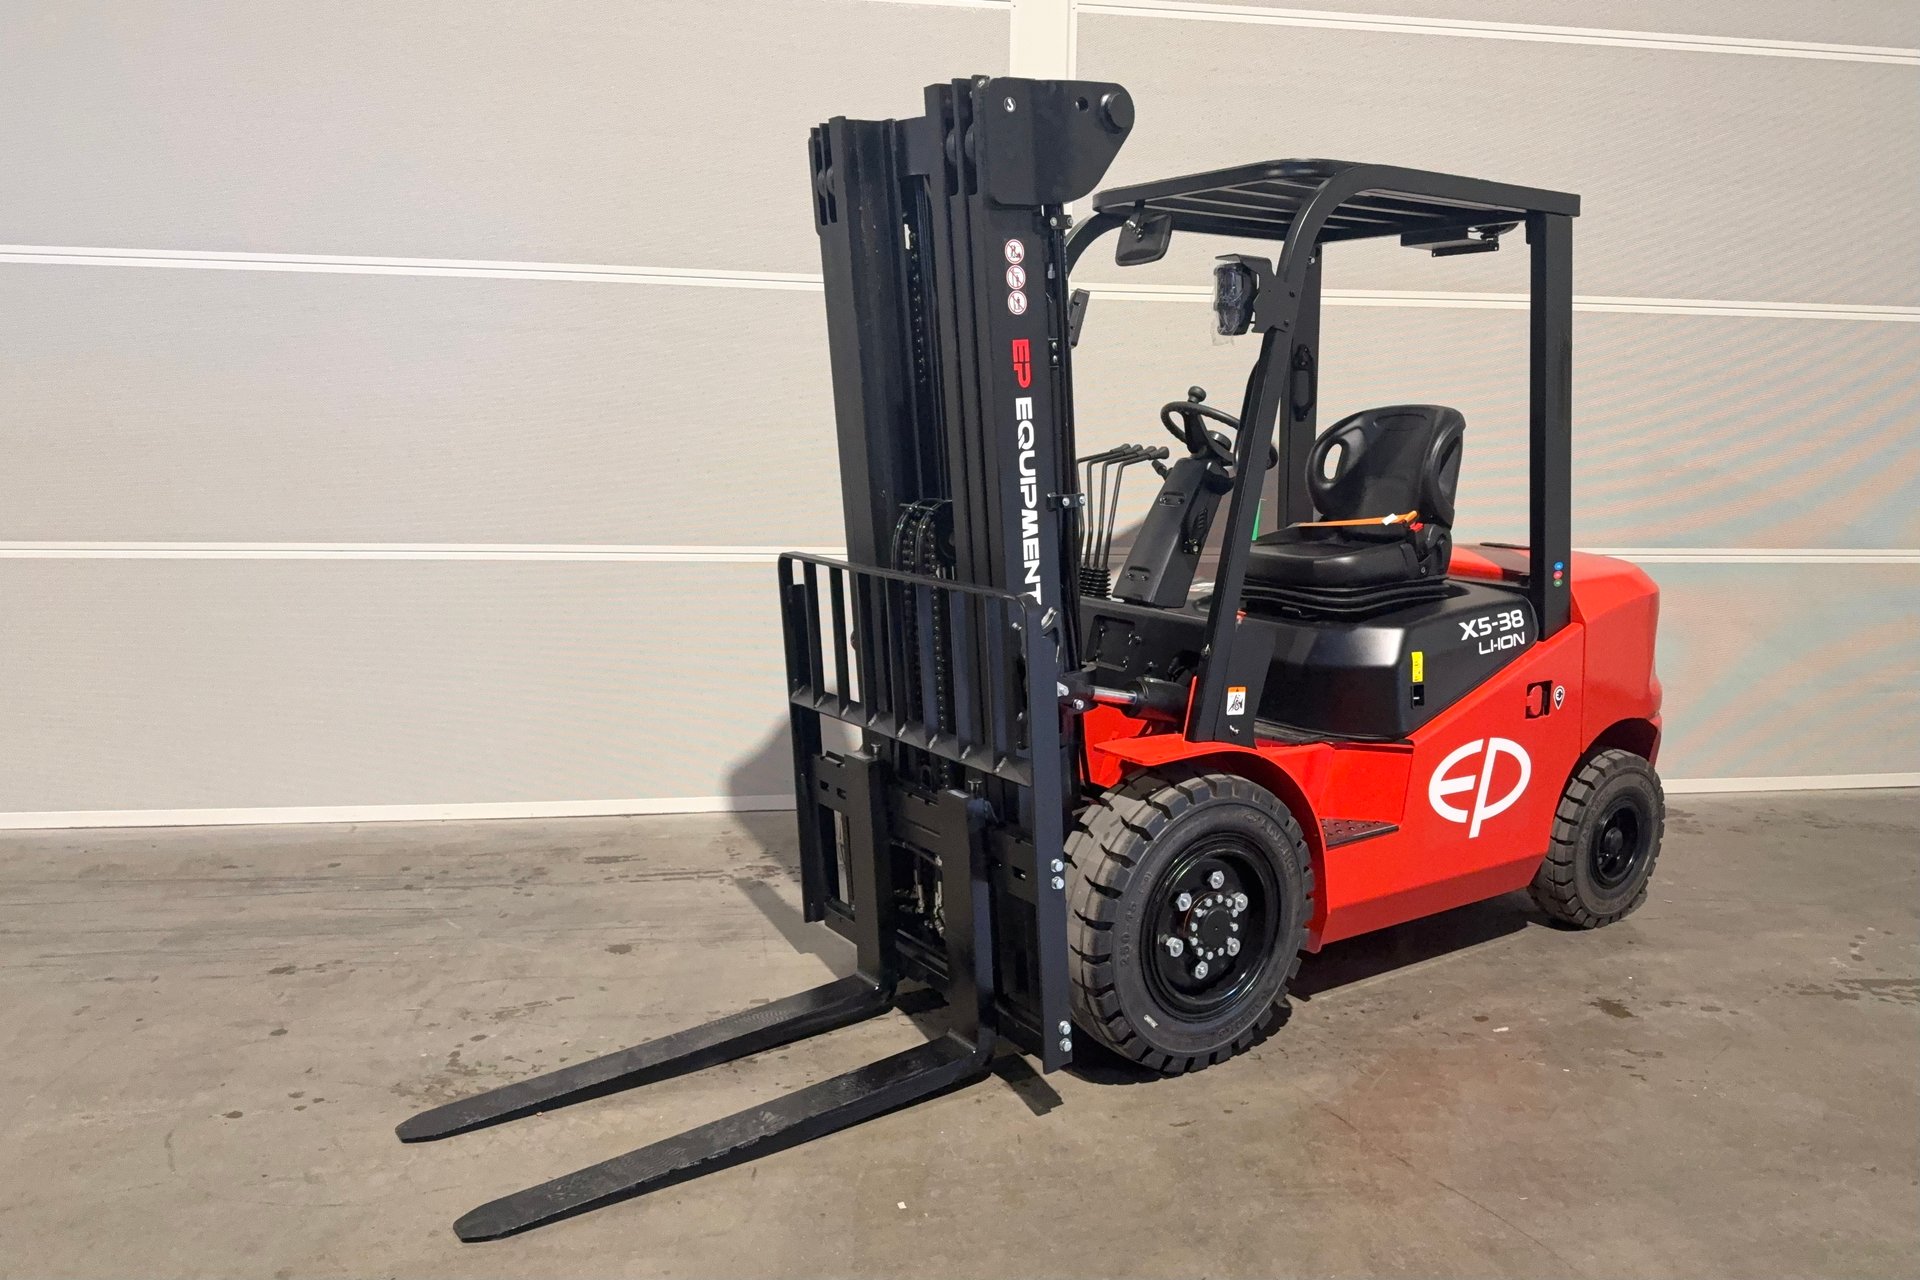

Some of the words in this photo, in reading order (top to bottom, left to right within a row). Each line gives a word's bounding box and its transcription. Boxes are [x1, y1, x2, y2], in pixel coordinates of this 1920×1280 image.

[1012, 338, 1033, 388] EP
[1015, 396, 1042, 605] EQUIPMENT
[1458, 609, 1525, 641] X5-38
[1479, 631, 1526, 655] LI-ION
